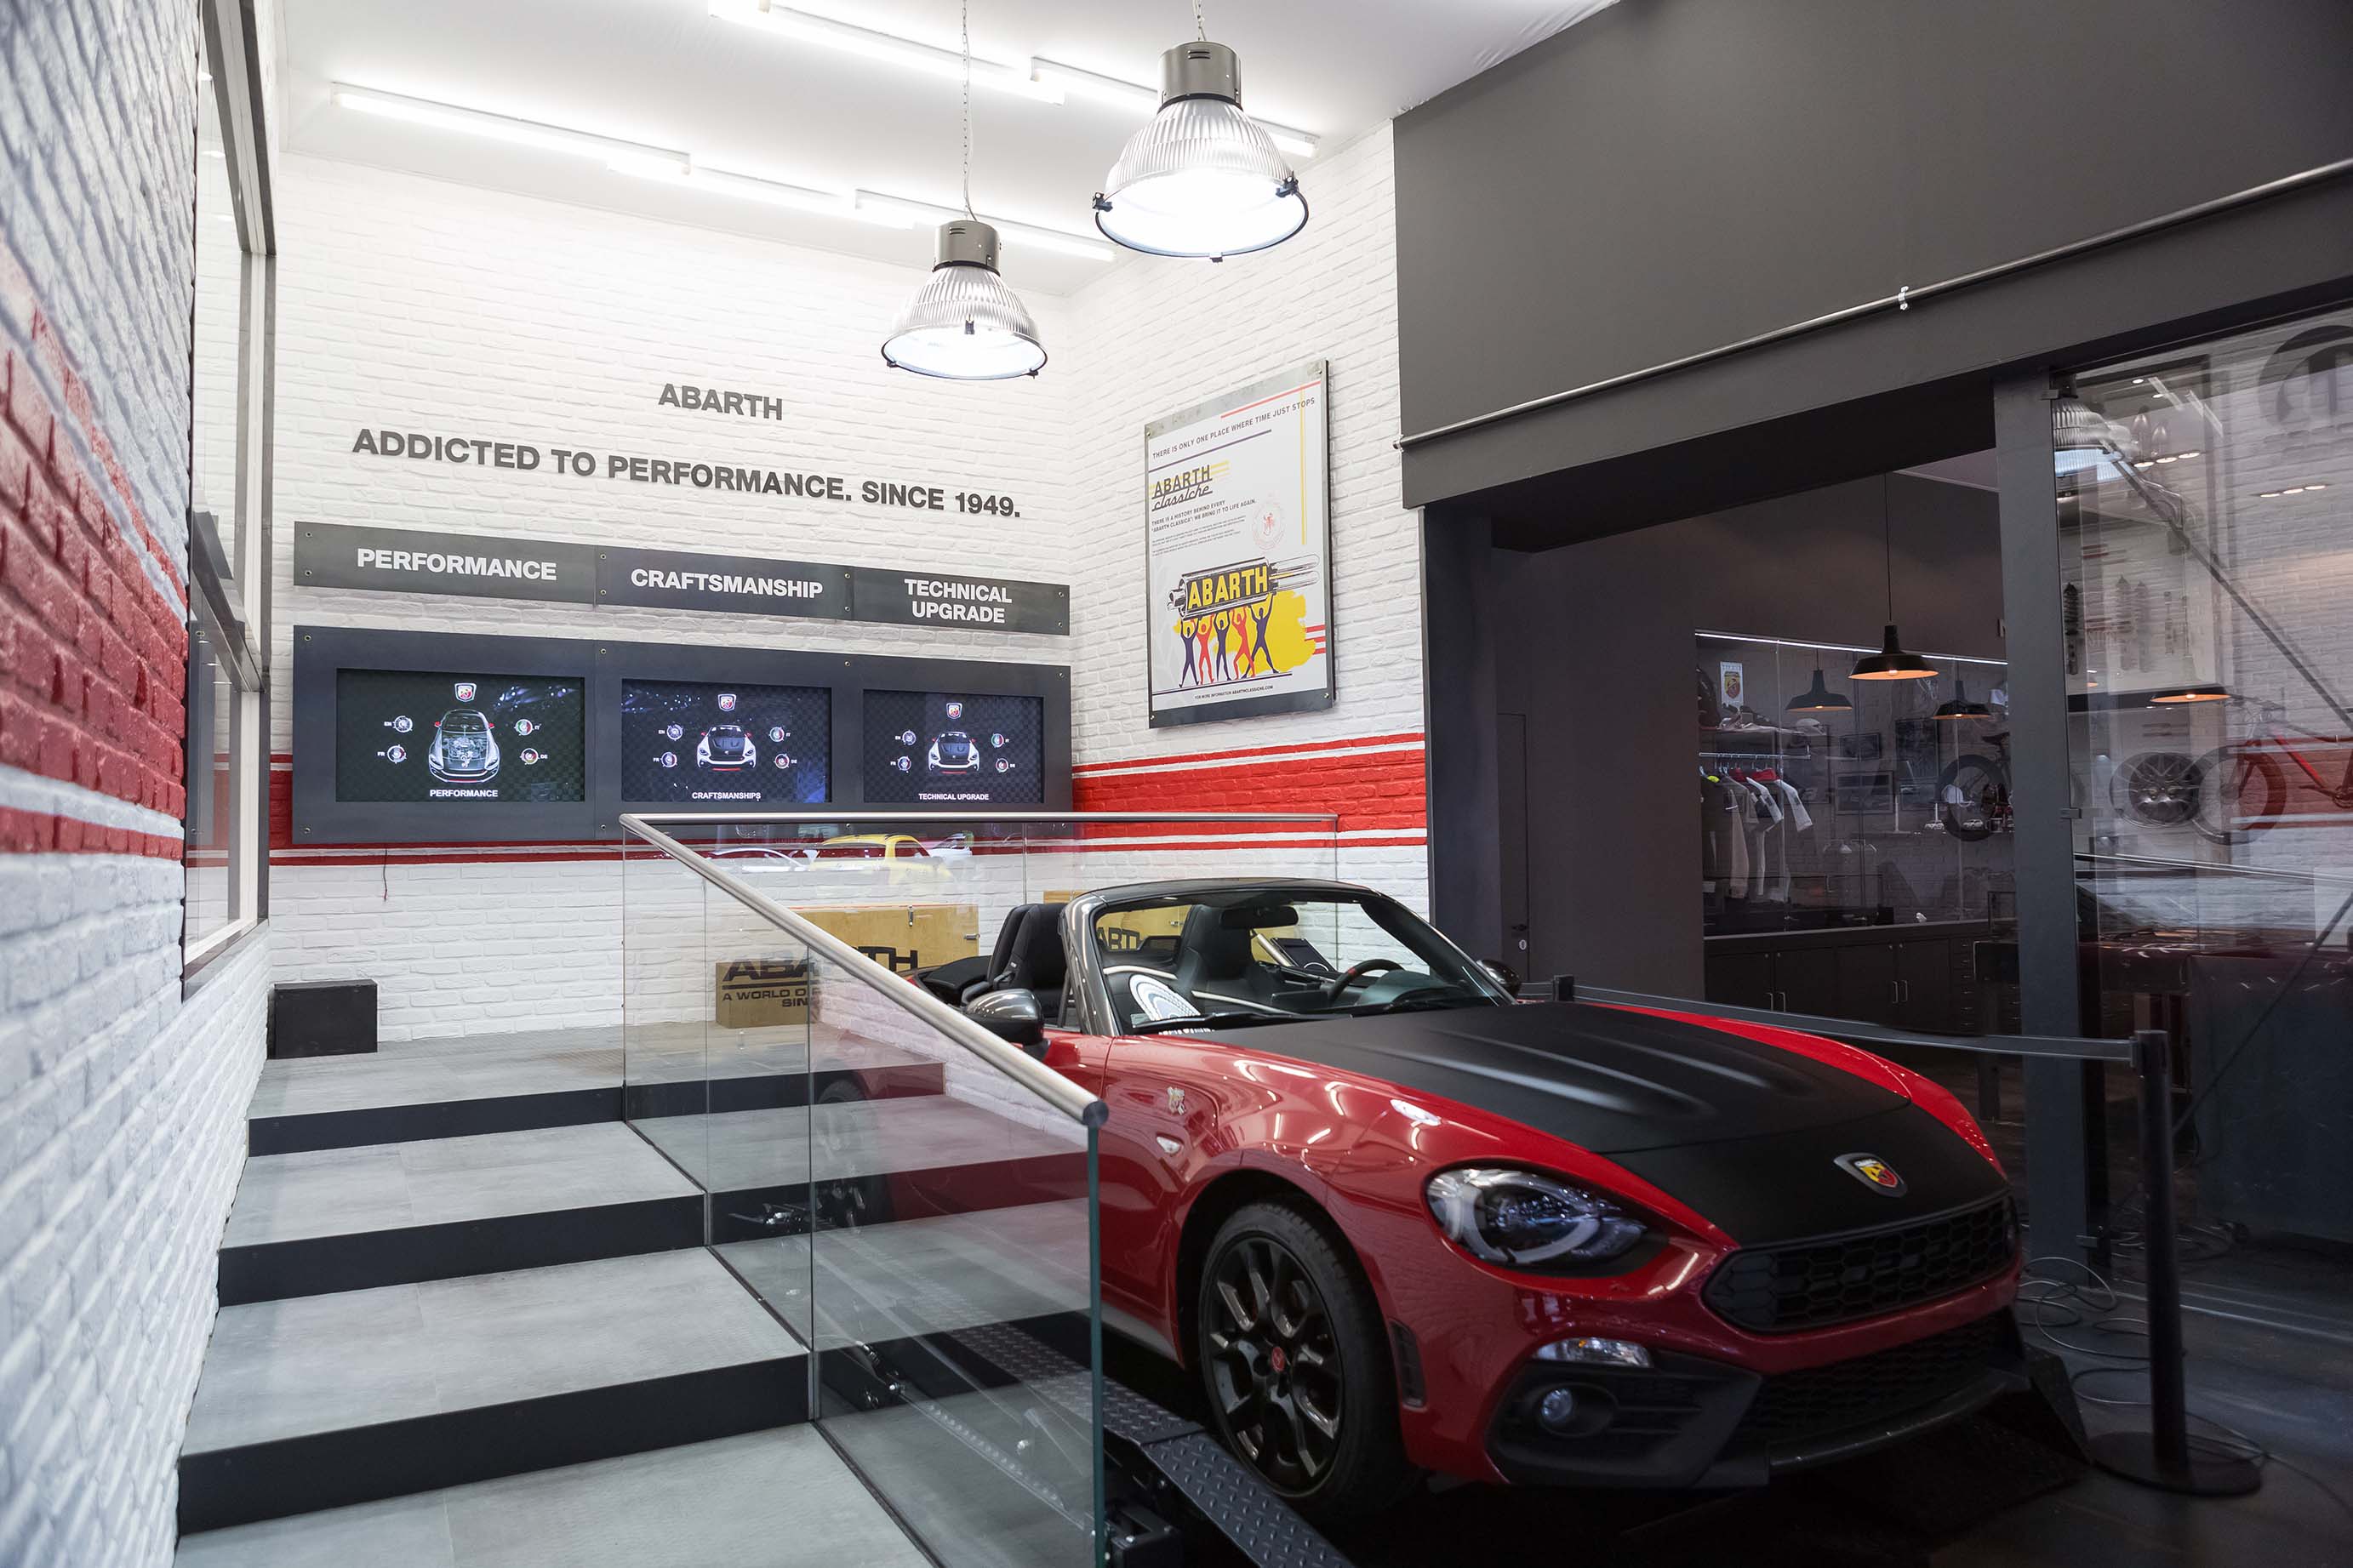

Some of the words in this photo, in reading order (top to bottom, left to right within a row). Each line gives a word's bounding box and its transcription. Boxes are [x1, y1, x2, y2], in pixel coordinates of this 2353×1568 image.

[658, 383, 782, 421] ABARTH
[1152, 448, 1171, 459] THERE
[1171, 444, 1178, 453] IS
[1179, 439, 1194, 449] ONLY
[1196, 434, 1208, 444] ONE
[1210, 426, 1230, 439] PLACE
[1231, 418, 1254, 431] WHERE
[1255, 412, 1271, 423] TIME
[1272, 406, 1290, 417] JUST
[1292, 397, 1315, 410] STOPS
[351, 428, 540, 470] ADDICTED
[551, 448, 596, 476] TO
[608, 455, 852, 502] PERFORMANCE.
[861, 480, 945, 510] SINCE
[955, 492, 1021, 518] 1949.
[1154, 465, 1211, 499] ABARTH
[1151, 484, 1213, 511] classiche
[1151, 517, 1165, 526] THERE
[1174, 510, 1192, 519] HISTORY
[1193, 505, 1210, 514] BEHIND
[1210, 500, 1225, 509] EVERY
[357, 547, 557, 582] PERFORMANCE
[631, 568, 824, 599] CRAFTSMANSHIP
[904, 579, 1013, 603] TECHNICAL
[1187, 566, 1268, 610] ABARTH
[911, 600, 1006, 624] UPGRADE
[429, 789, 499, 798] PERFORMANCE
[691, 791, 762, 801] CRAFTSMANSHIPS
[722, 992, 733, 1001] A
[736, 989, 791, 1001] WORLD
